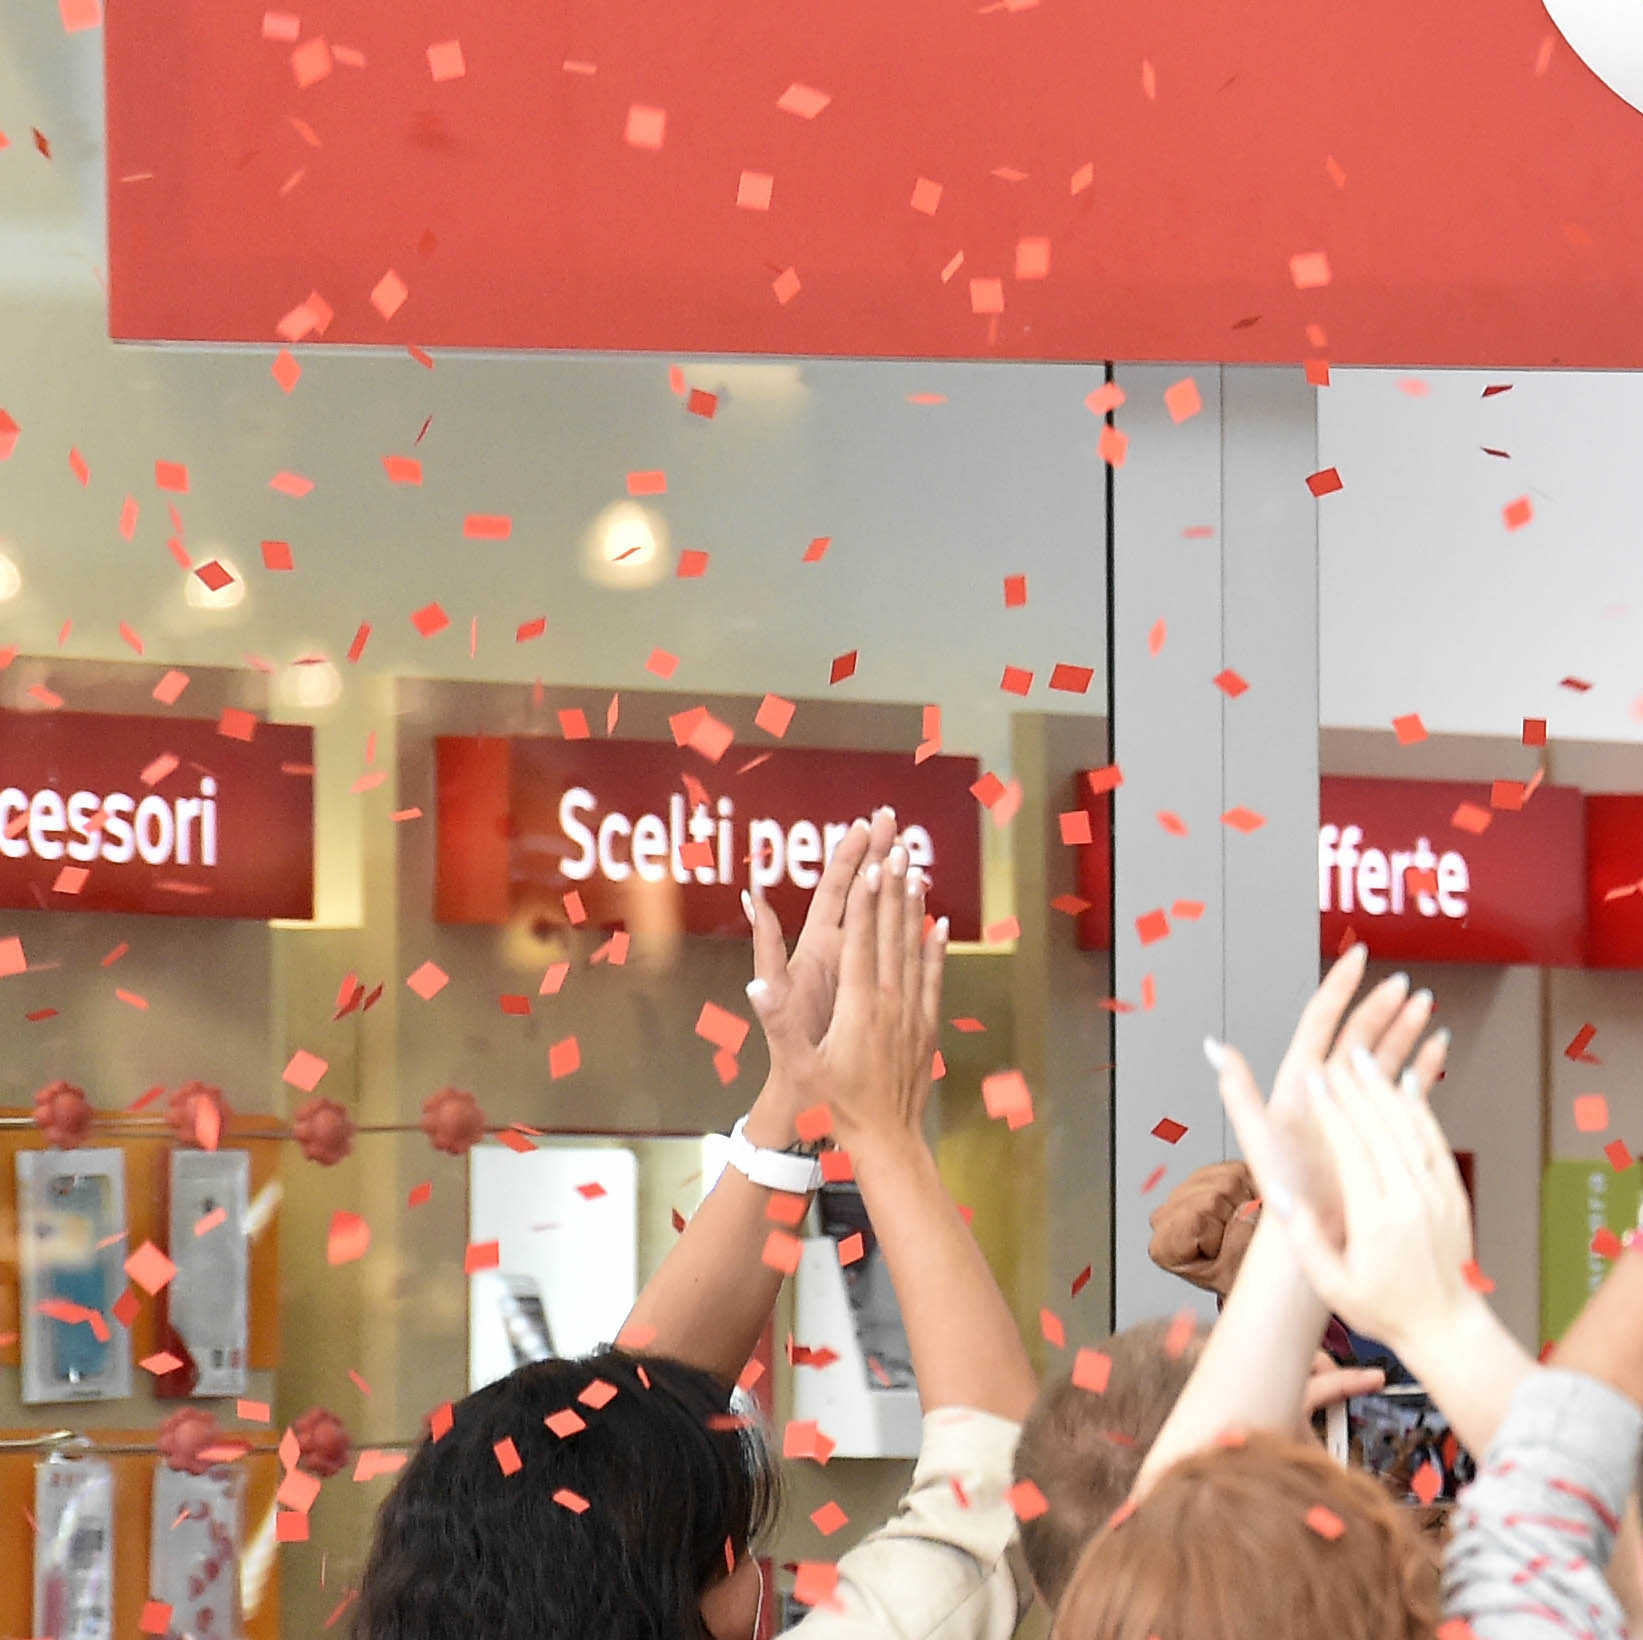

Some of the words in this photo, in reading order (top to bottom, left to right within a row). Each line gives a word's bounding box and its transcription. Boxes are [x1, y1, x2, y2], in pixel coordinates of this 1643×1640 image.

[0, 776, 217, 867] cessori
[557, 787, 734, 886] Scelti
[1318, 823, 1471, 918] fferte
